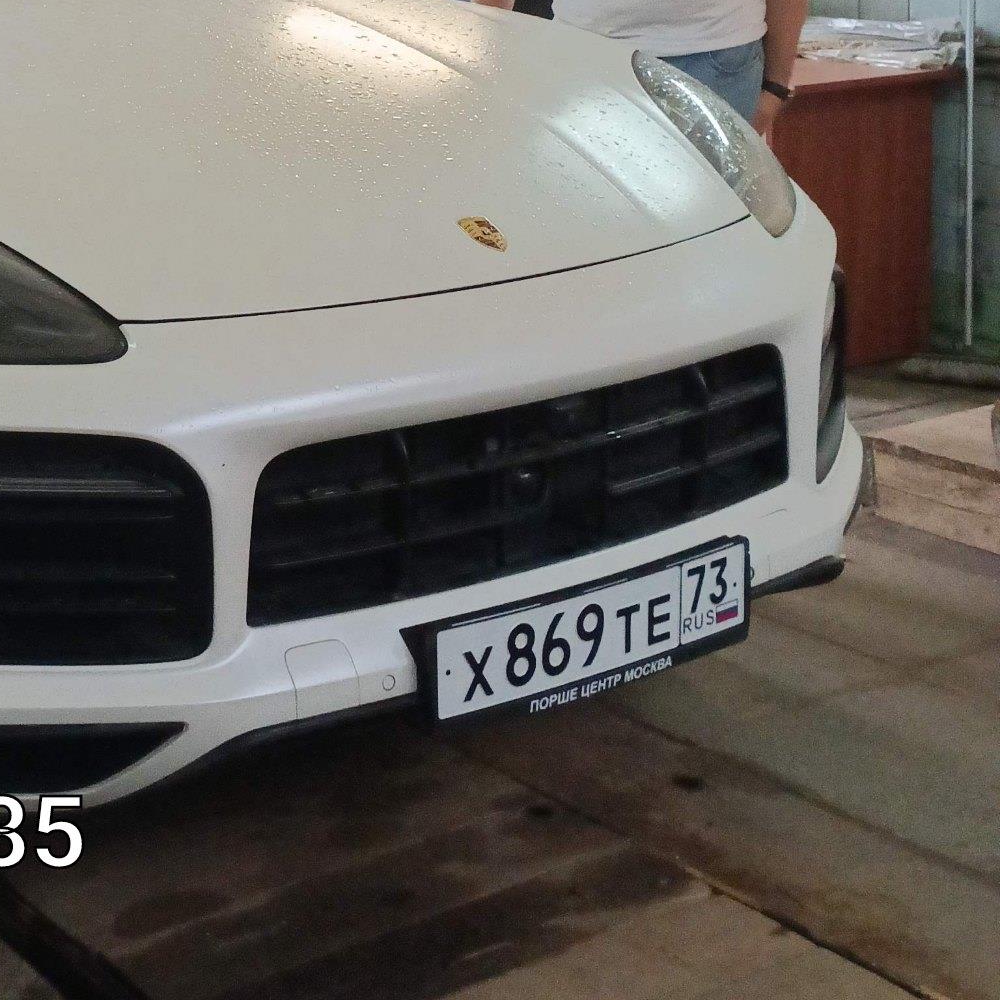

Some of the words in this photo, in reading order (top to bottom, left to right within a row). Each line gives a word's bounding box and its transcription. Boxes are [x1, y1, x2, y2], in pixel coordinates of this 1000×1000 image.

[687, 557, 728, 614] 73
[683, 614, 715, 635] RUS
[529, 687, 579, 713] ПОРШЕ
[581, 674, 622, 698] ЦЕНТР
[624, 656, 673, 683] МОСКВА
